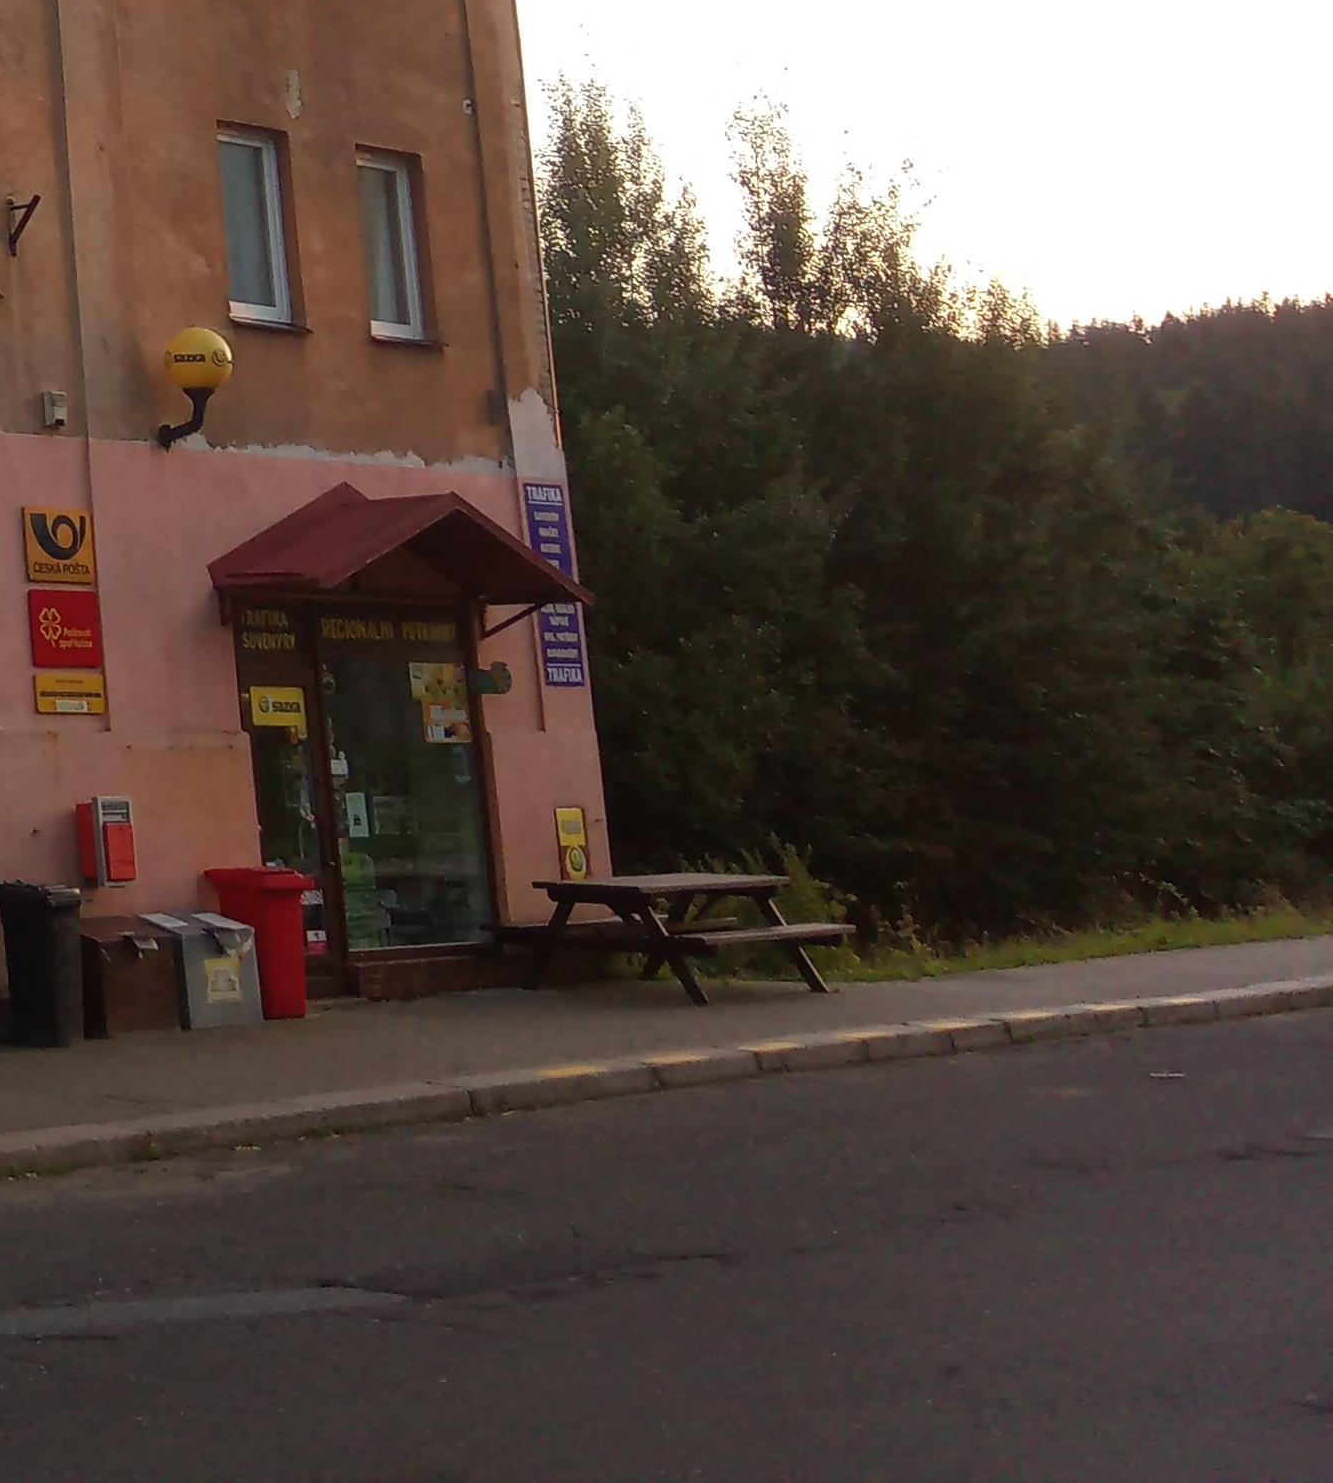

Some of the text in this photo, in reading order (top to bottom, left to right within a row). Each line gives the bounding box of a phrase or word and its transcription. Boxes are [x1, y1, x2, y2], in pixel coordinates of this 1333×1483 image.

[174, 353, 205, 363] sazka
[526, 485, 563, 502] TRAFIKA
[33, 561, 90, 575] ČESKÁ POŠTA
[241, 609, 290, 628] TRAFIKA
[547, 666, 583, 683] TRAFIKA
